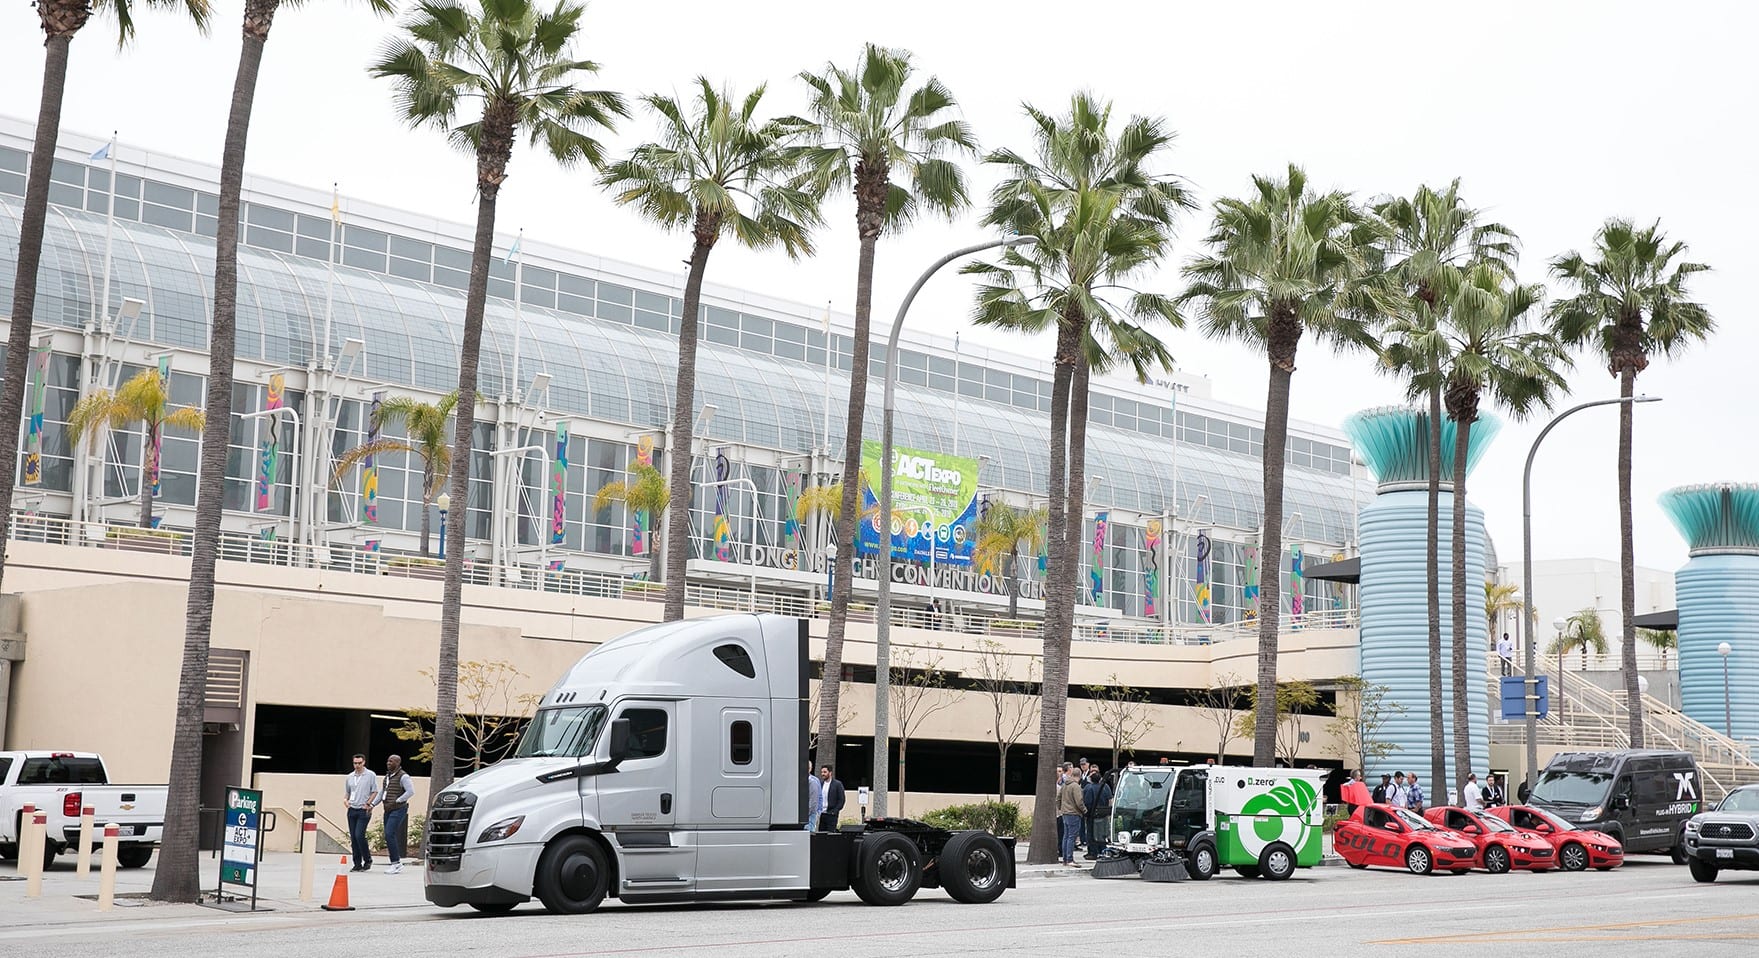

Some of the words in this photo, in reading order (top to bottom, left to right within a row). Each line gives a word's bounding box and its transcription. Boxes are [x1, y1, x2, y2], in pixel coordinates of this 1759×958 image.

[740, 544, 798, 571] LONG
[891, 562, 1007, 597] CONVENTION
[230, 789, 257, 814] Parking
[1669, 803, 1692, 815] HYBRID
[233, 836, 247, 844] EXPO
[234, 827, 248, 837] ACT
[1340, 829, 1402, 860] SOLO
